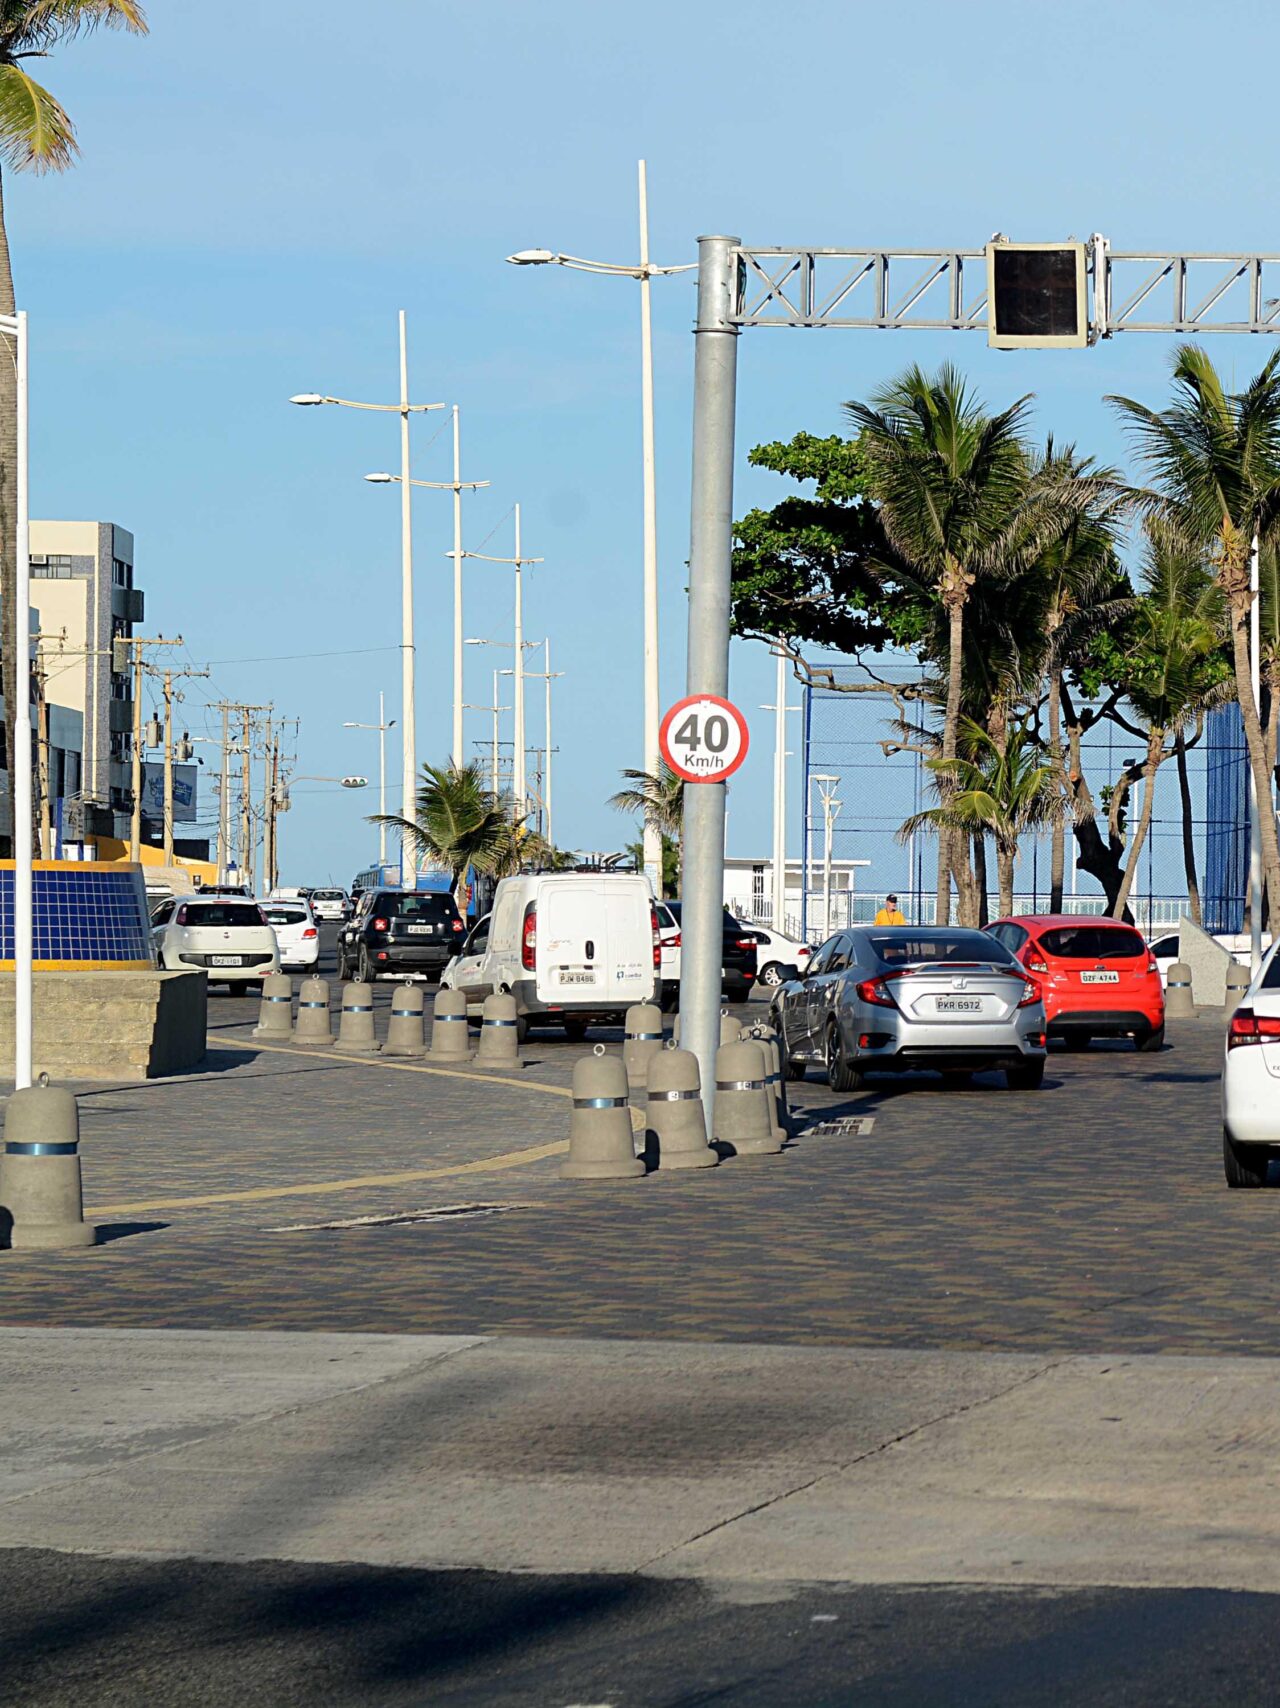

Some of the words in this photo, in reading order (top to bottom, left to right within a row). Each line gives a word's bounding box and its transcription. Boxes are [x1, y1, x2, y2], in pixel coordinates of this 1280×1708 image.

[675, 713, 729, 753] 40
[685, 754, 724, 767] Km/h
[938, 1001, 955, 1010] PKR
[957, 1001, 980, 1010] 6972
